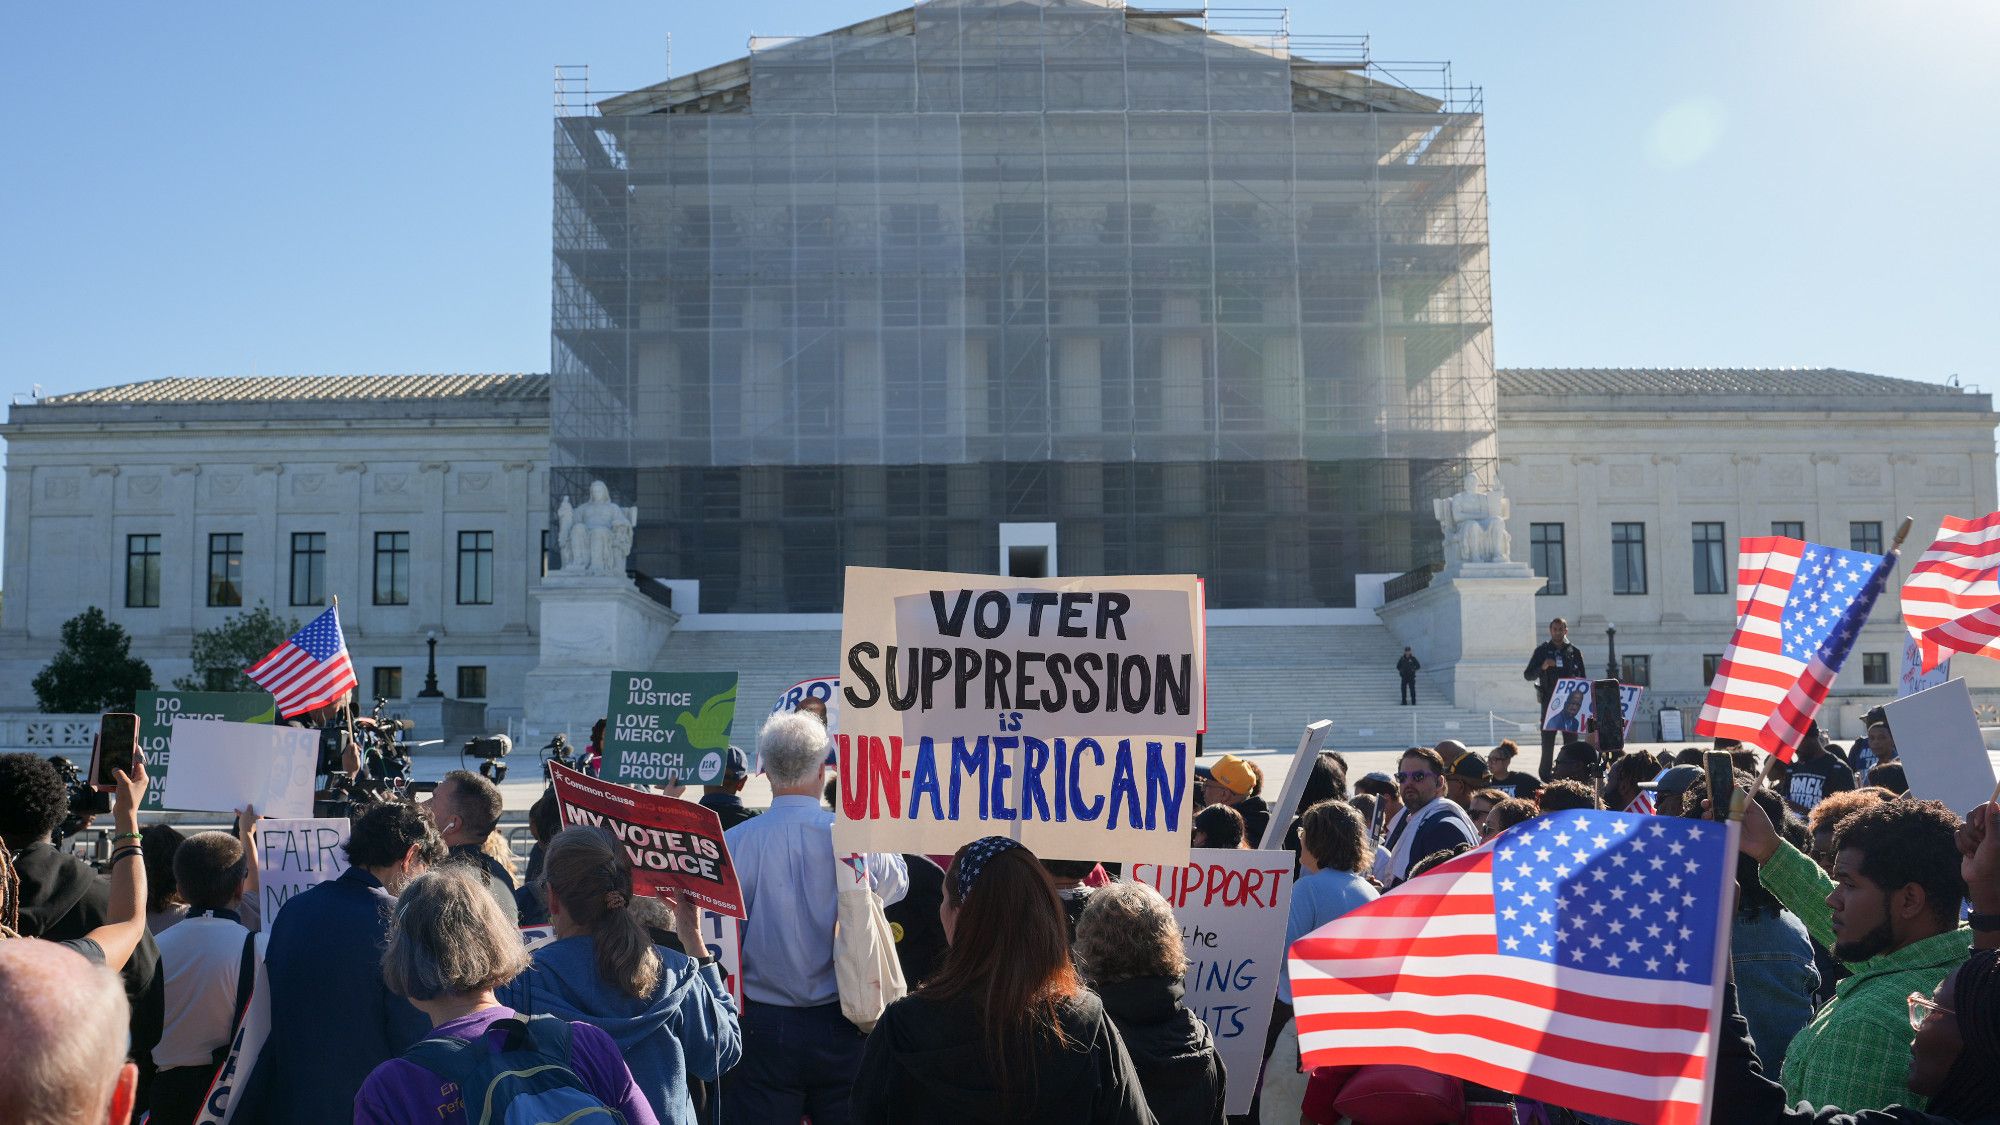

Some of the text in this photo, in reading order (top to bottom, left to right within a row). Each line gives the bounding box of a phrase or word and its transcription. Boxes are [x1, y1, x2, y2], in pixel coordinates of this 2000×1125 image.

[929, 589, 1131, 641] VOTER
[629, 677, 653, 691] DO
[843, 642, 1192, 716] SUPPRESSION
[155, 697, 181, 712] DO
[626, 692, 692, 706] JUSTICE
[616, 714, 659, 728] LOVE
[999, 712, 1023, 732] is
[614, 728, 675, 743] MERCY
[620, 750, 684, 767] MARCH
[618, 765, 695, 781] PROUDLY
[833, 734, 1187, 832] UN-AMERICAN
[565, 776, 604, 798] Common
[604, 791, 635, 807] Cause
[565, 802, 720, 861] MY VOTE IS
[263, 828, 341, 872] FAIR
[623, 845, 719, 881] VOICE
[1132, 862, 1290, 909] SUPPORT
[701, 894, 712, 903] TO
[1181, 925, 1219, 949] the
